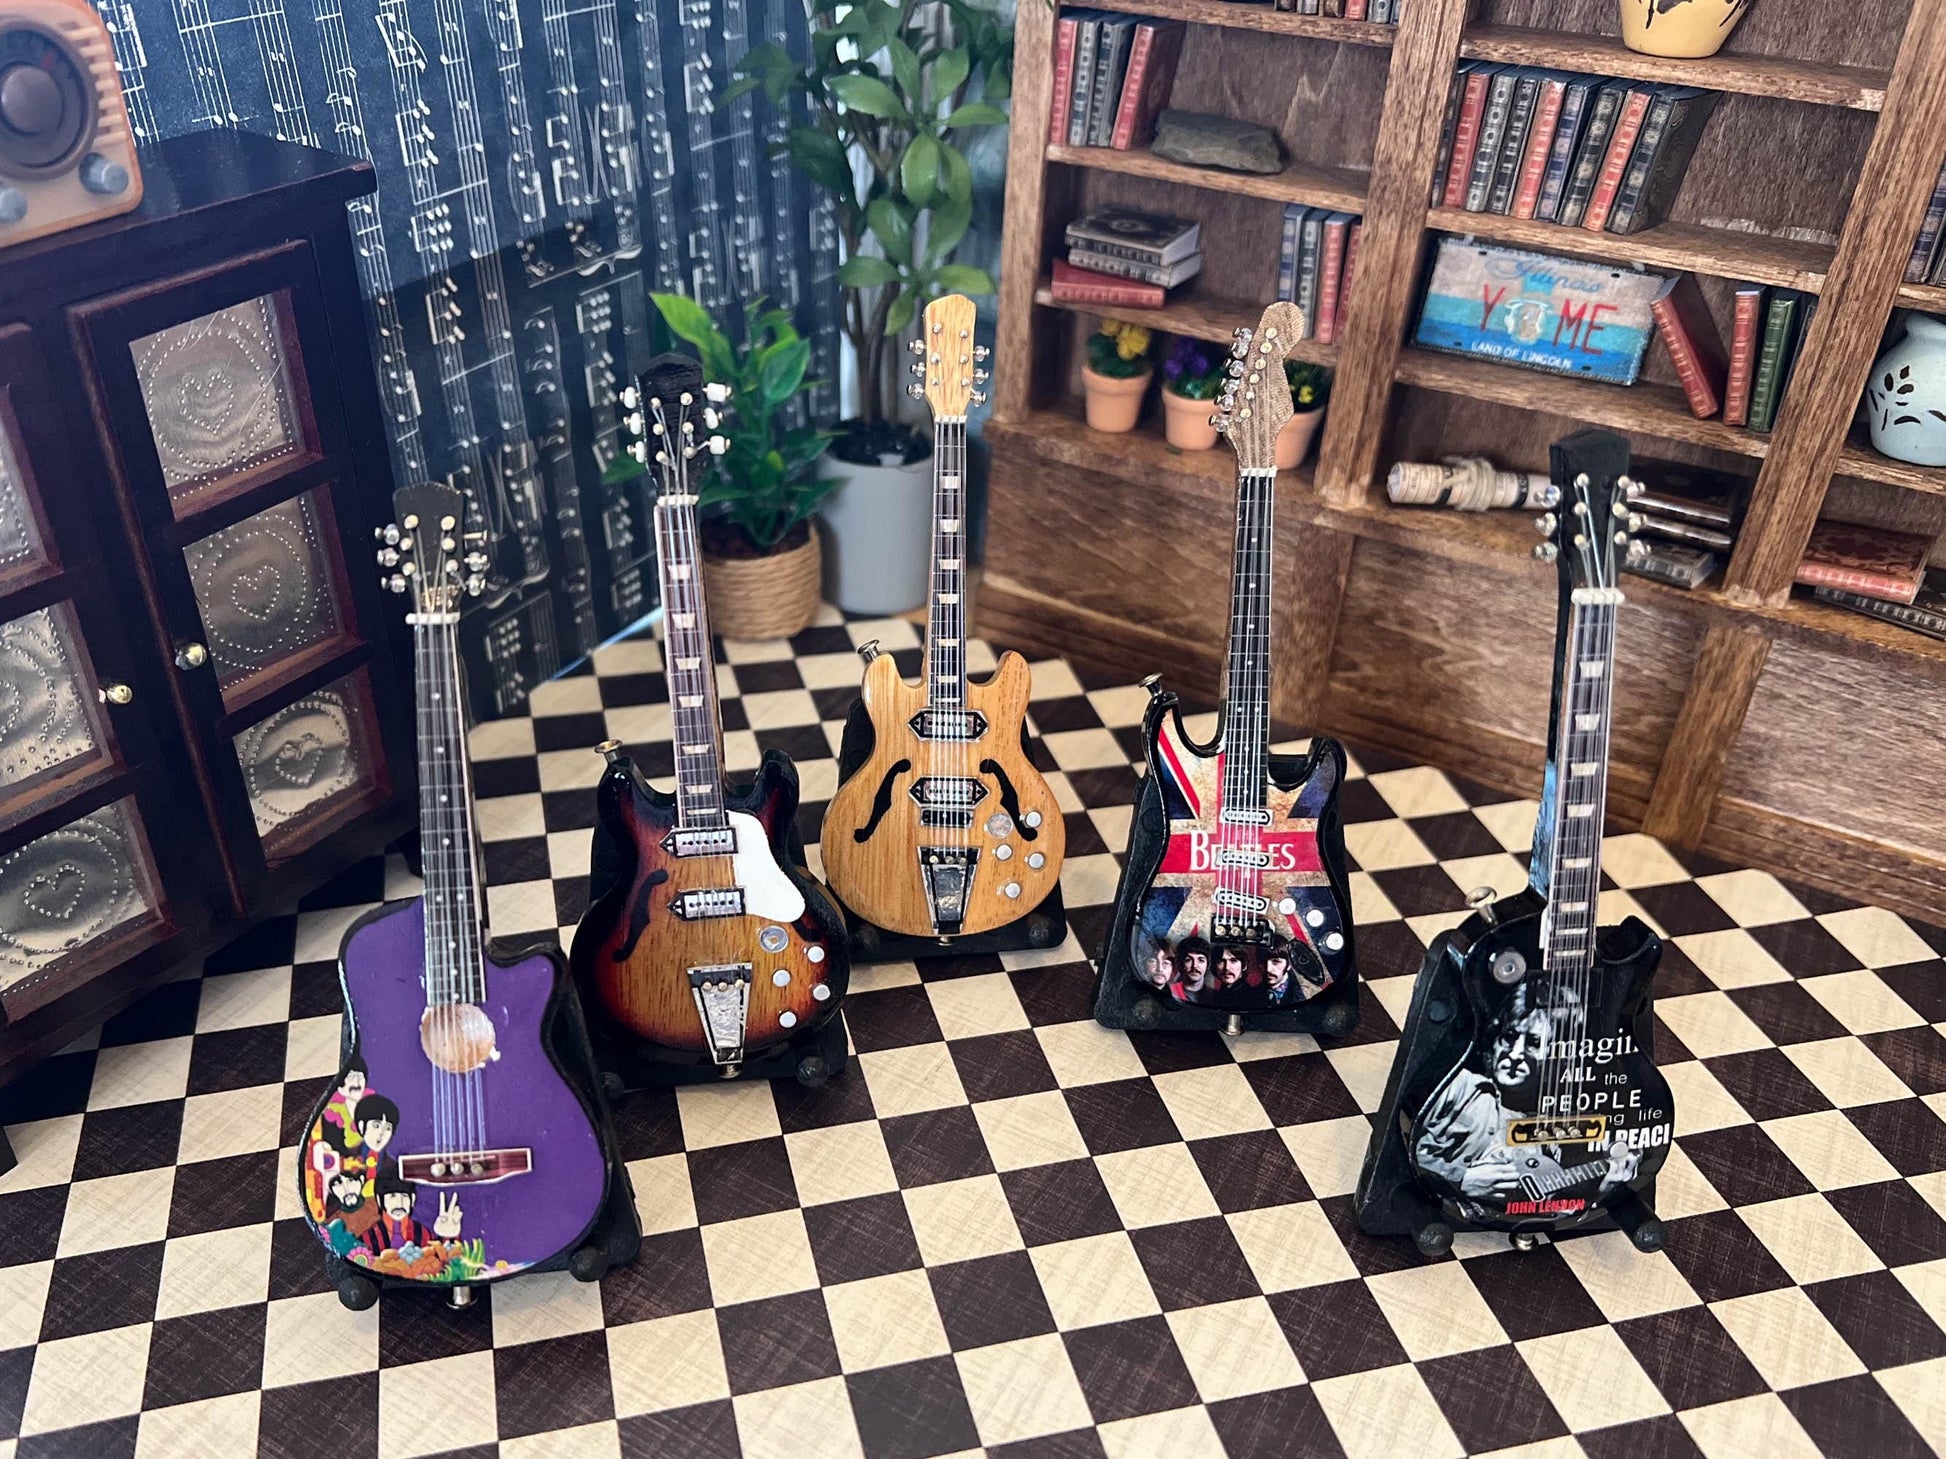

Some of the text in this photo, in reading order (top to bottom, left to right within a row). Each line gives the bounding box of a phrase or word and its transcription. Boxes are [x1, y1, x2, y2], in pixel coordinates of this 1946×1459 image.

[1480, 284, 1618, 355] Y ME
[1471, 340, 1573, 370] LAND OF LINCOLN
[1560, 1066, 1628, 1086] ALL the
[1541, 1089, 1642, 1113] PEOPLE
[1638, 1107, 1663, 1121] life
[1505, 1198, 1586, 1215] JOHN LENNON
